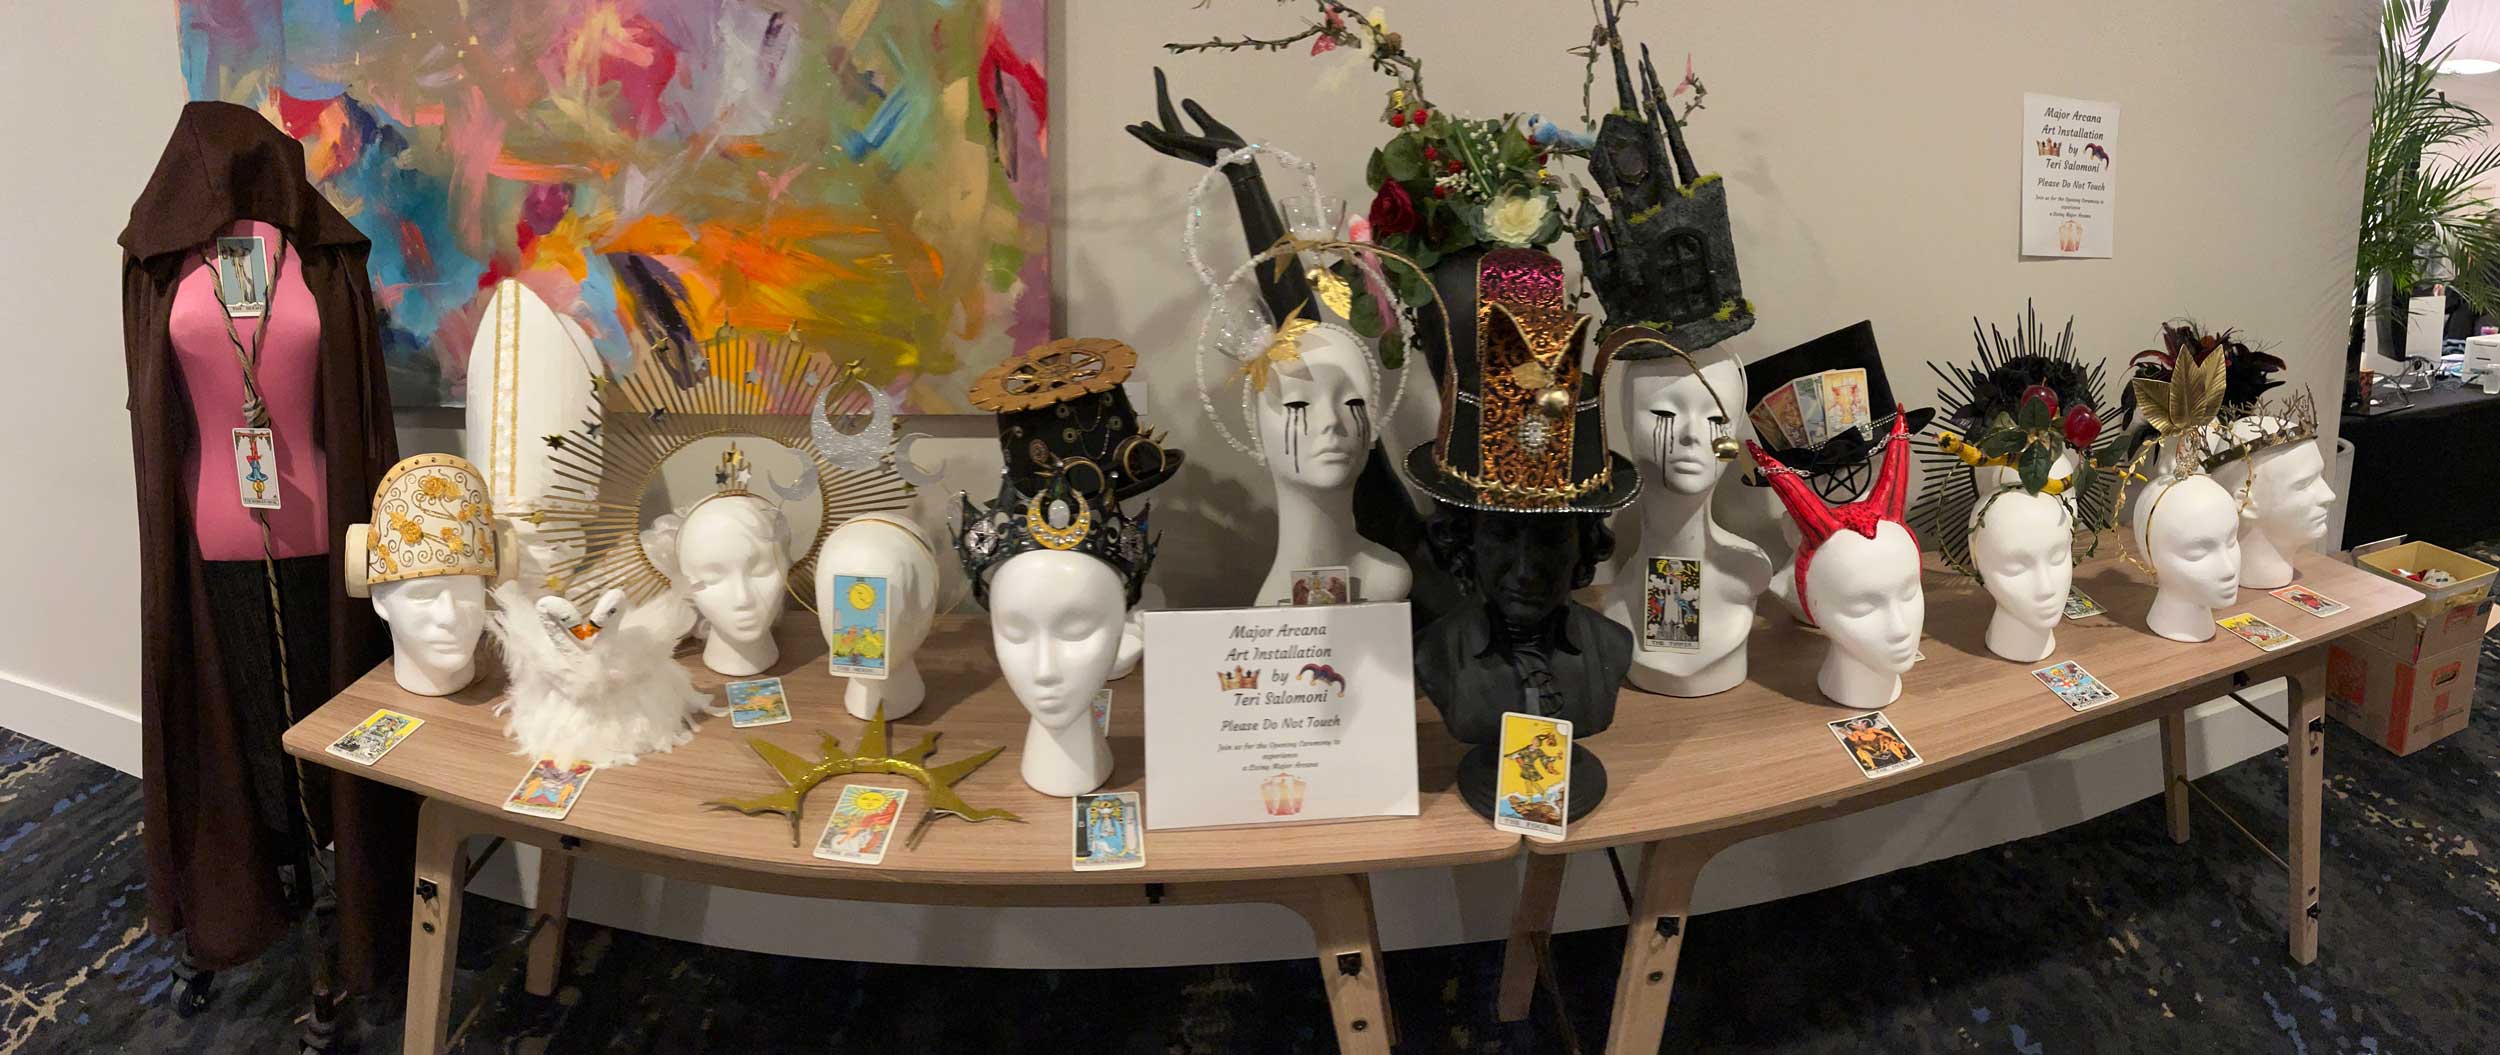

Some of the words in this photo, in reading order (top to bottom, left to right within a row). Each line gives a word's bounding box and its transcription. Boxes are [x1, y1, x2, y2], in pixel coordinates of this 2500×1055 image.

[2044, 106, 2070, 121] Major
[2072, 110, 2102, 123] Arcana
[2042, 124, 2056, 135] Art
[2058, 126, 2104, 140] Installation
[2068, 144, 2078, 157] by
[2046, 158, 2061, 169] Teri
[2064, 160, 2100, 172] Salomoni
[2037, 178, 2060, 188] Please
[2062, 179, 2071, 188] Do
[2072, 180, 2085, 189] Not
[2087, 182, 2105, 191] Touch
[1229, 625, 1274, 642] Major
[1276, 624, 1327, 637] Arcana
[1224, 648, 1249, 661] Art
[1253, 644, 1332, 660] Installation
[1271, 669, 1289, 685] by
[1234, 692, 1261, 706] Teri
[1265, 690, 1328, 705] Salomoni
[1220, 720, 1259, 731] Please
[1262, 719, 1278, 730] Do
[1281, 718, 1304, 728] Not
[1307, 715, 1341, 728] Touch
[1217, 744, 1231, 752] Join
[1244, 742, 1255, 750] for
